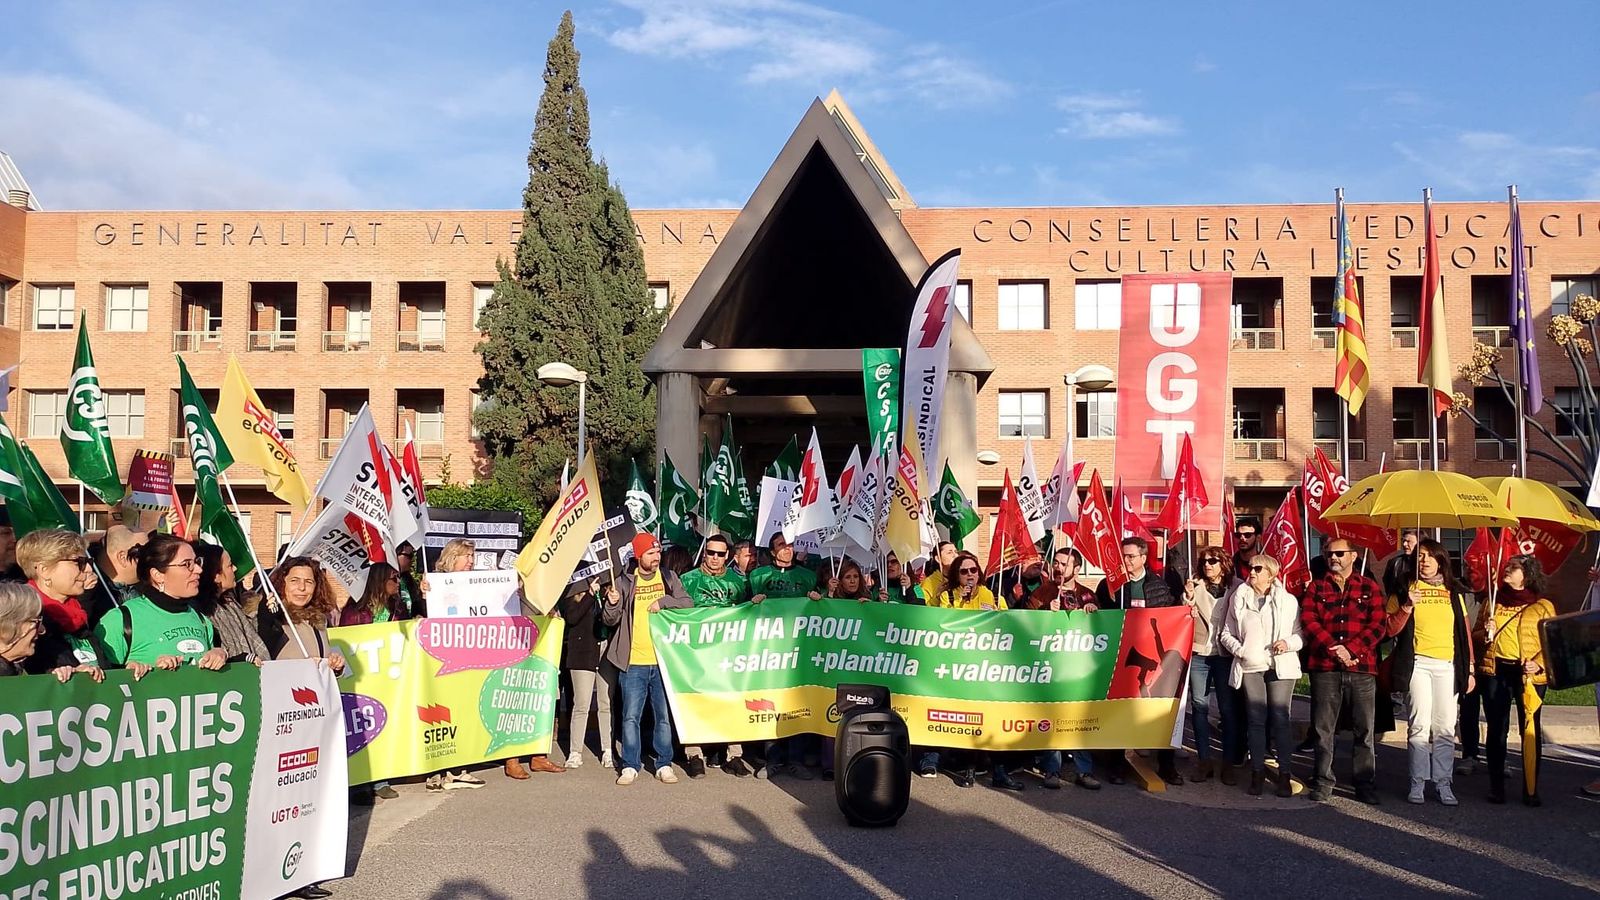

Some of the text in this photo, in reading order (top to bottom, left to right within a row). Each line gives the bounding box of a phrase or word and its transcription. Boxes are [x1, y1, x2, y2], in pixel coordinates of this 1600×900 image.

[94, 221, 719, 246] GENERALITAT VALEANA
[973, 216, 1297, 243] CONSELLERIA
[1068, 245, 1538, 273] CULTURA I ESPORT
[1145, 282, 1202, 480] UGT
[469, 605, 489, 617] NO
[662, 615, 1110, 653] JA N'HI HA PROU! -burocràcia -ràtios
[718, 648, 1054, 685] +salari +plantilla +valencià
[502, 667, 549, 690] CENTRES
[491, 689, 553, 713] EDUCATIUS
[277, 708, 325, 724] INTERSINDICAL
[749, 712, 781, 724] STEPV
[929, 711, 965, 724] CCOO
[1002, 719, 1036, 733] UGT
[275, 724, 293, 736] STAS
[424, 726, 458, 744] STEPV
[927, 723, 983, 737] educació
[277, 765, 318, 787] educació
[271, 807, 291, 824] UGT
